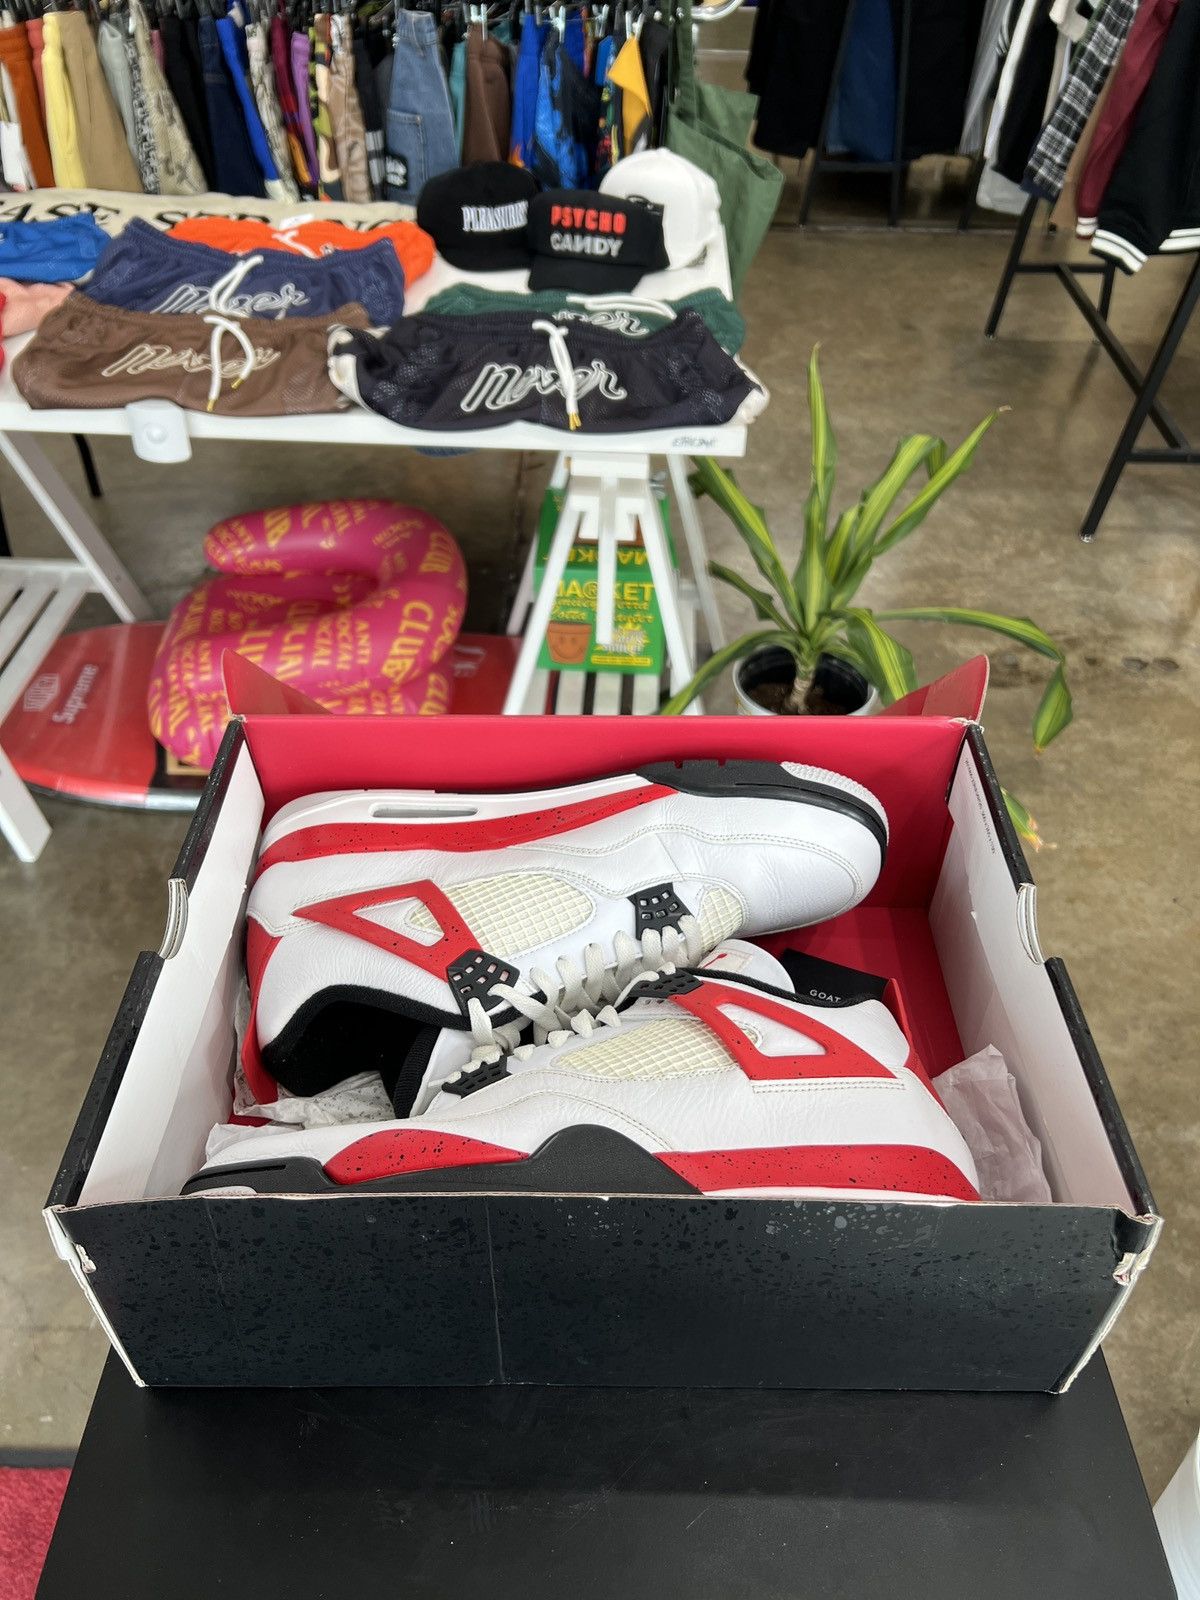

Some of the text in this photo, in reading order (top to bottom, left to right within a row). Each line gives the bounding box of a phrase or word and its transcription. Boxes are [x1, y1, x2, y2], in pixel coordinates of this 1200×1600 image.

[551, 206, 627, 235] PSYCHO
[381, 601, 434, 685] CLUB
[52, 663, 100, 725] Supreme
[809, 989, 842, 1003] GOAT
